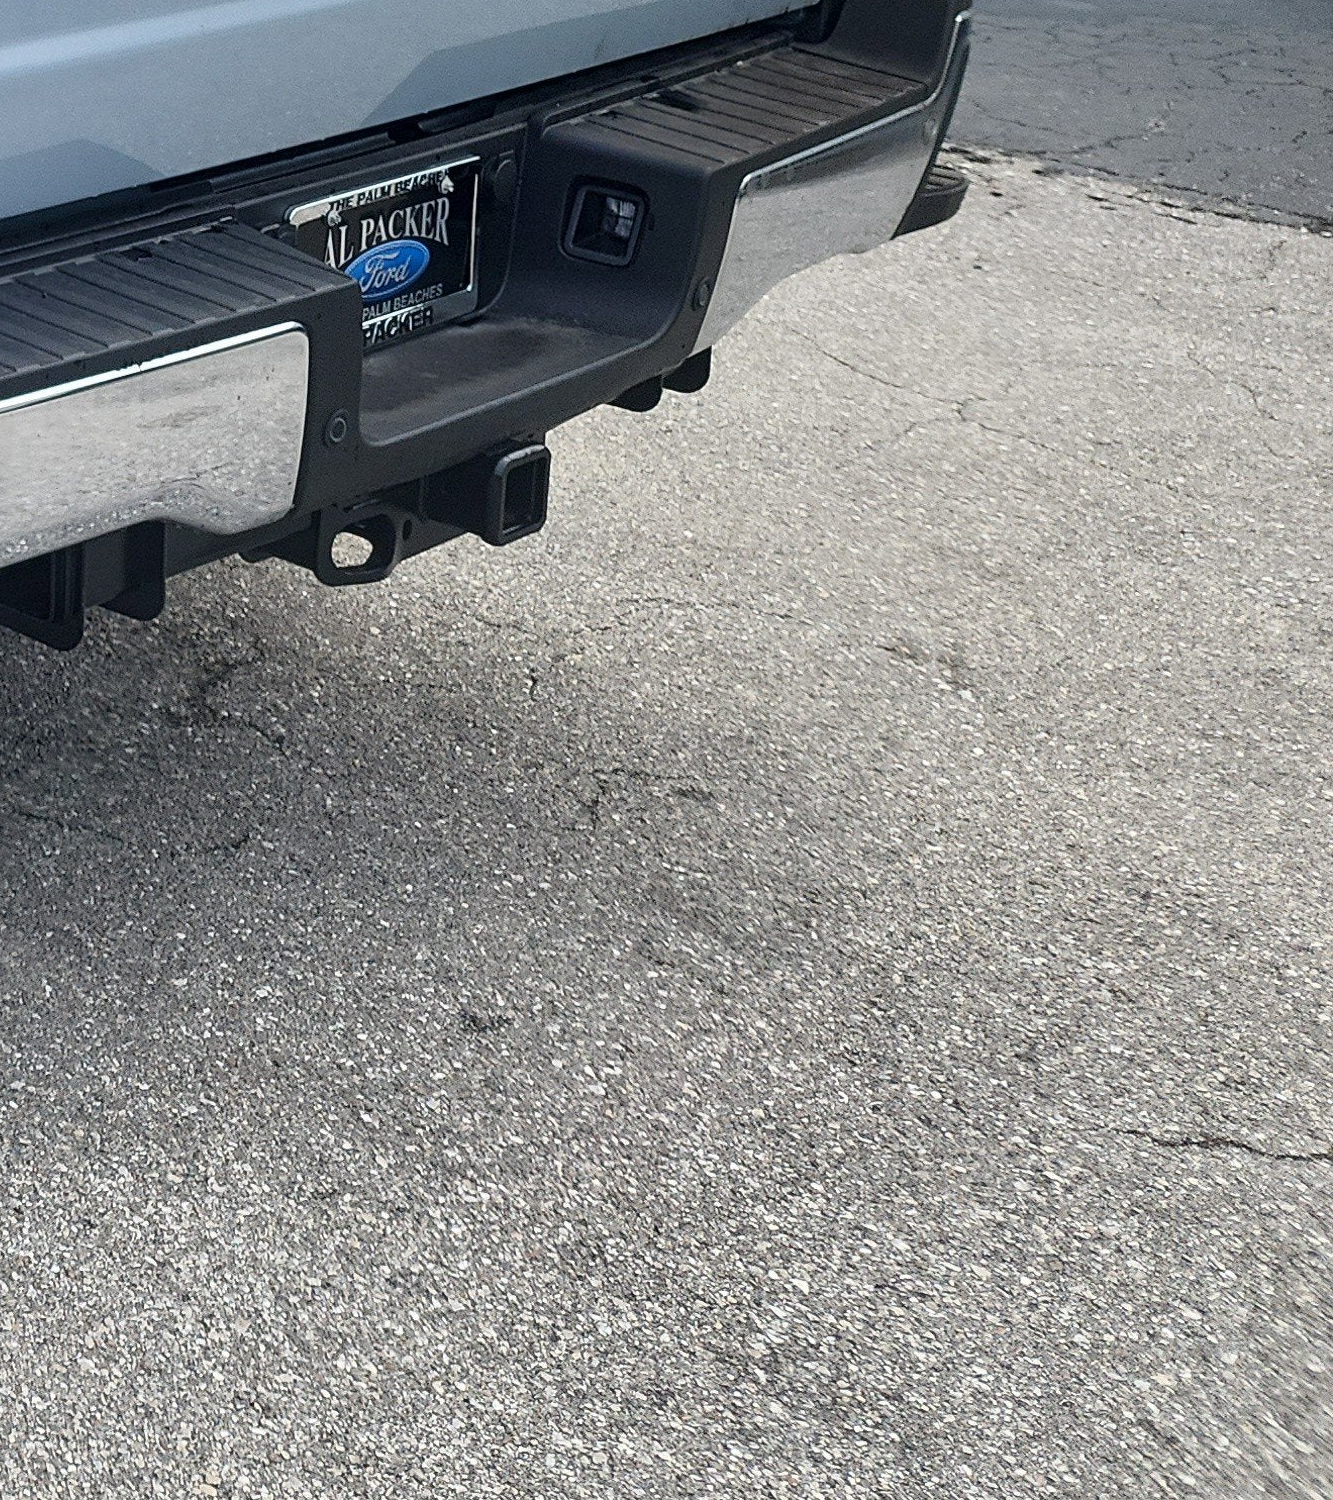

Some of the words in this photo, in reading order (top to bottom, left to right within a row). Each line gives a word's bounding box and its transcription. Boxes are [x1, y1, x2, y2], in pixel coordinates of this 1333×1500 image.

[356, 184, 392, 207] PALM
[324, 224, 354, 269] AL
[359, 197, 449, 252] PACKER
[359, 252, 410, 292] Ford
[362, 300, 391, 322] PALM
[394, 283, 444, 311] BEACHES
